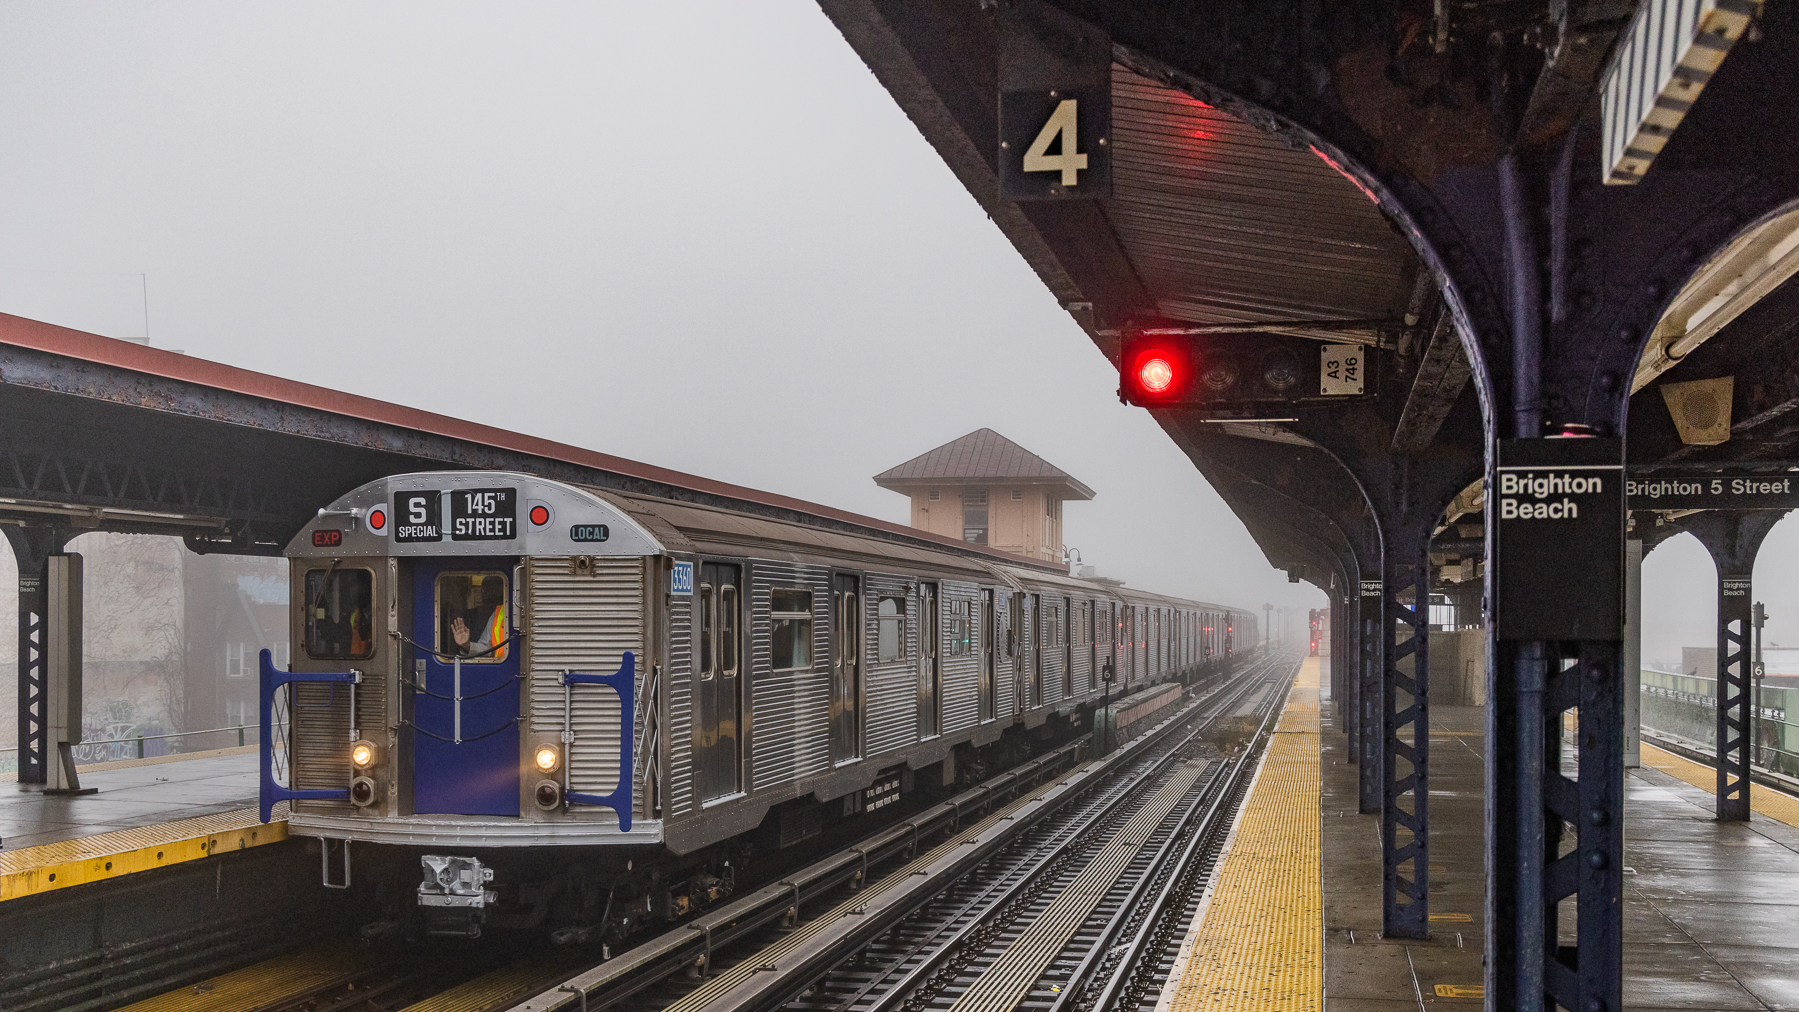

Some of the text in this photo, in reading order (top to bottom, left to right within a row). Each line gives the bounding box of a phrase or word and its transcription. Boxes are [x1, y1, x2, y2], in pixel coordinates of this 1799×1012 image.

[1023, 99, 1088, 186] 4
[1327, 356, 1341, 379] A3
[1345, 357, 1358, 383] 746
[1501, 473, 1602, 499] Brighton
[1626, 478, 1791, 498] Brighton 5 Street
[408, 497, 427, 523] S
[1501, 498, 1578, 519] Beach
[398, 525, 438, 538] SPECIAL
[456, 517, 513, 535] STREET
[572, 527, 607, 540] LOCAL
[315, 532, 340, 545] EXP
[20, 580, 40, 588] Brighton
[673, 566, 692, 590] 3360
[1361, 582, 1383, 590] Brighto
[1723, 582, 1750, 590] Brighton
[1104, 670, 1110, 678] 6
[1755, 665, 1763, 675] 6
